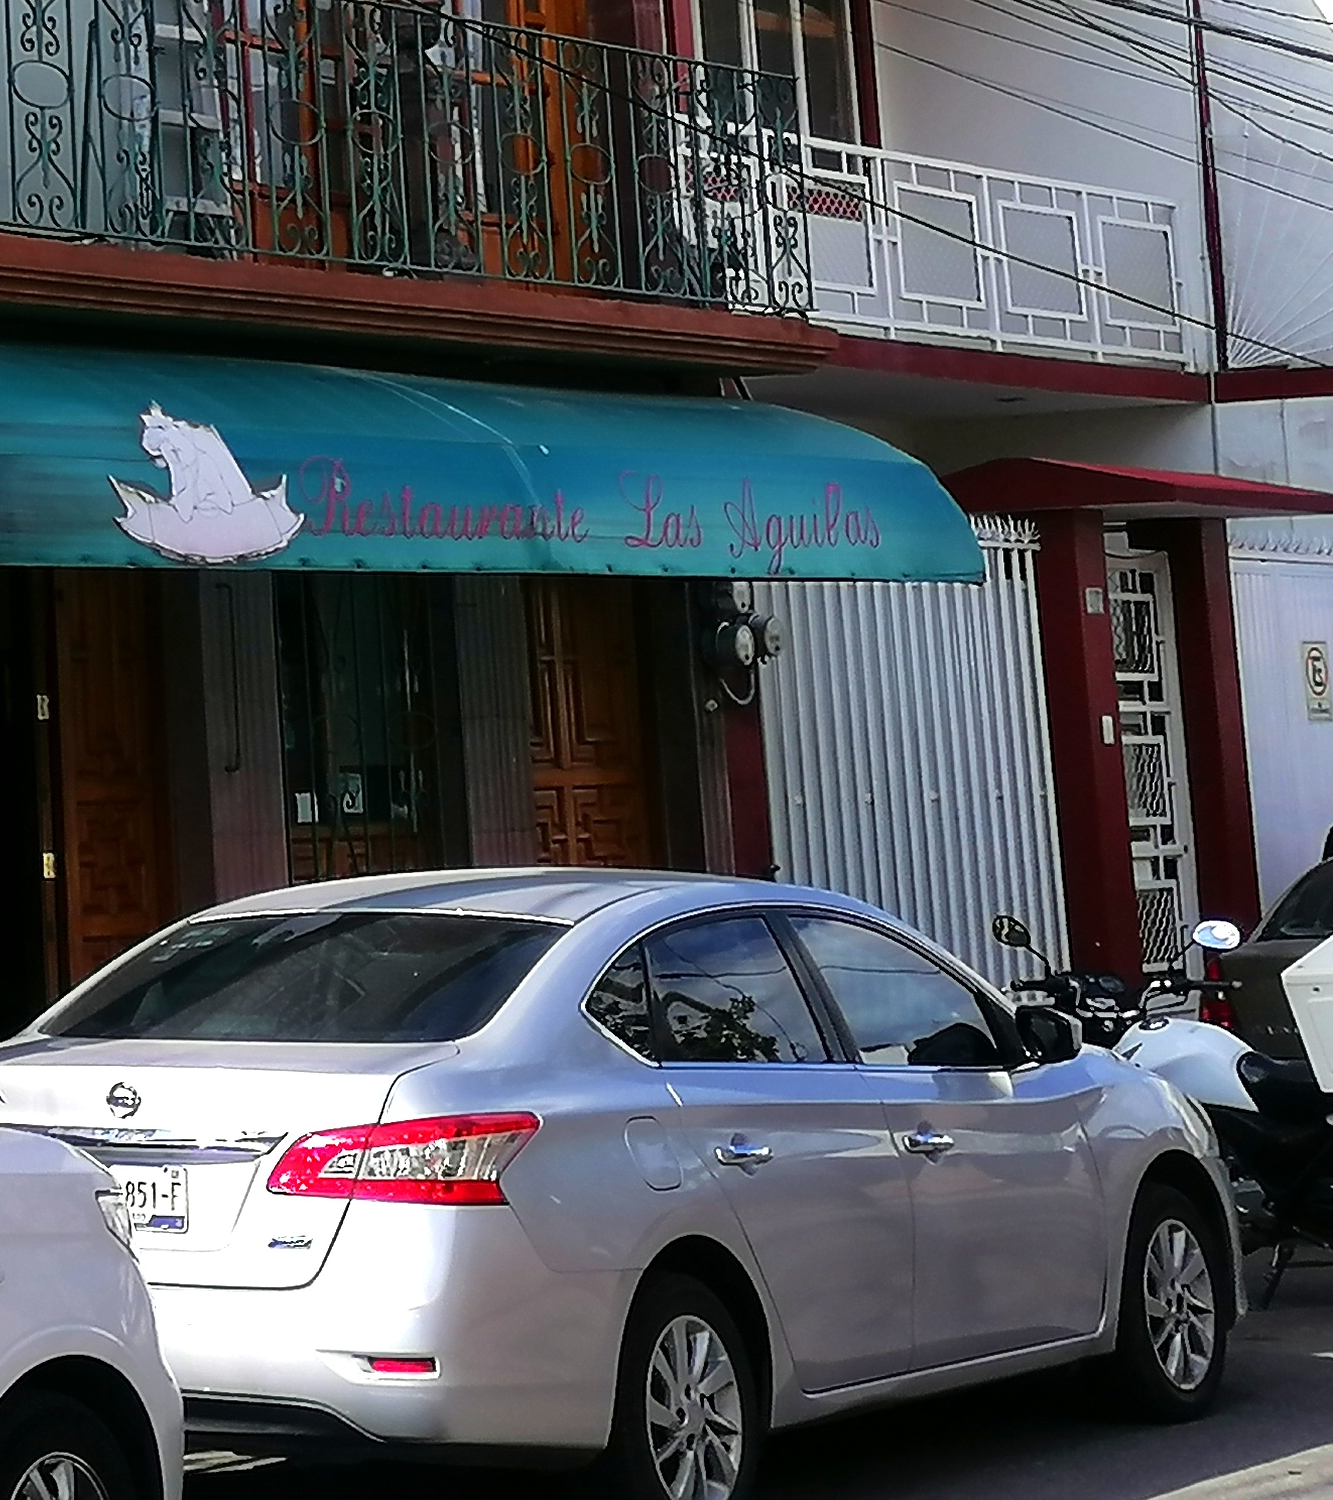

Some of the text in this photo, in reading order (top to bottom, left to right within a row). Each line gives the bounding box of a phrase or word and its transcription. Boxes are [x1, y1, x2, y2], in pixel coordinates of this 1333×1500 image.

[299, 455, 882, 576] Restaurante Las Aguilas
